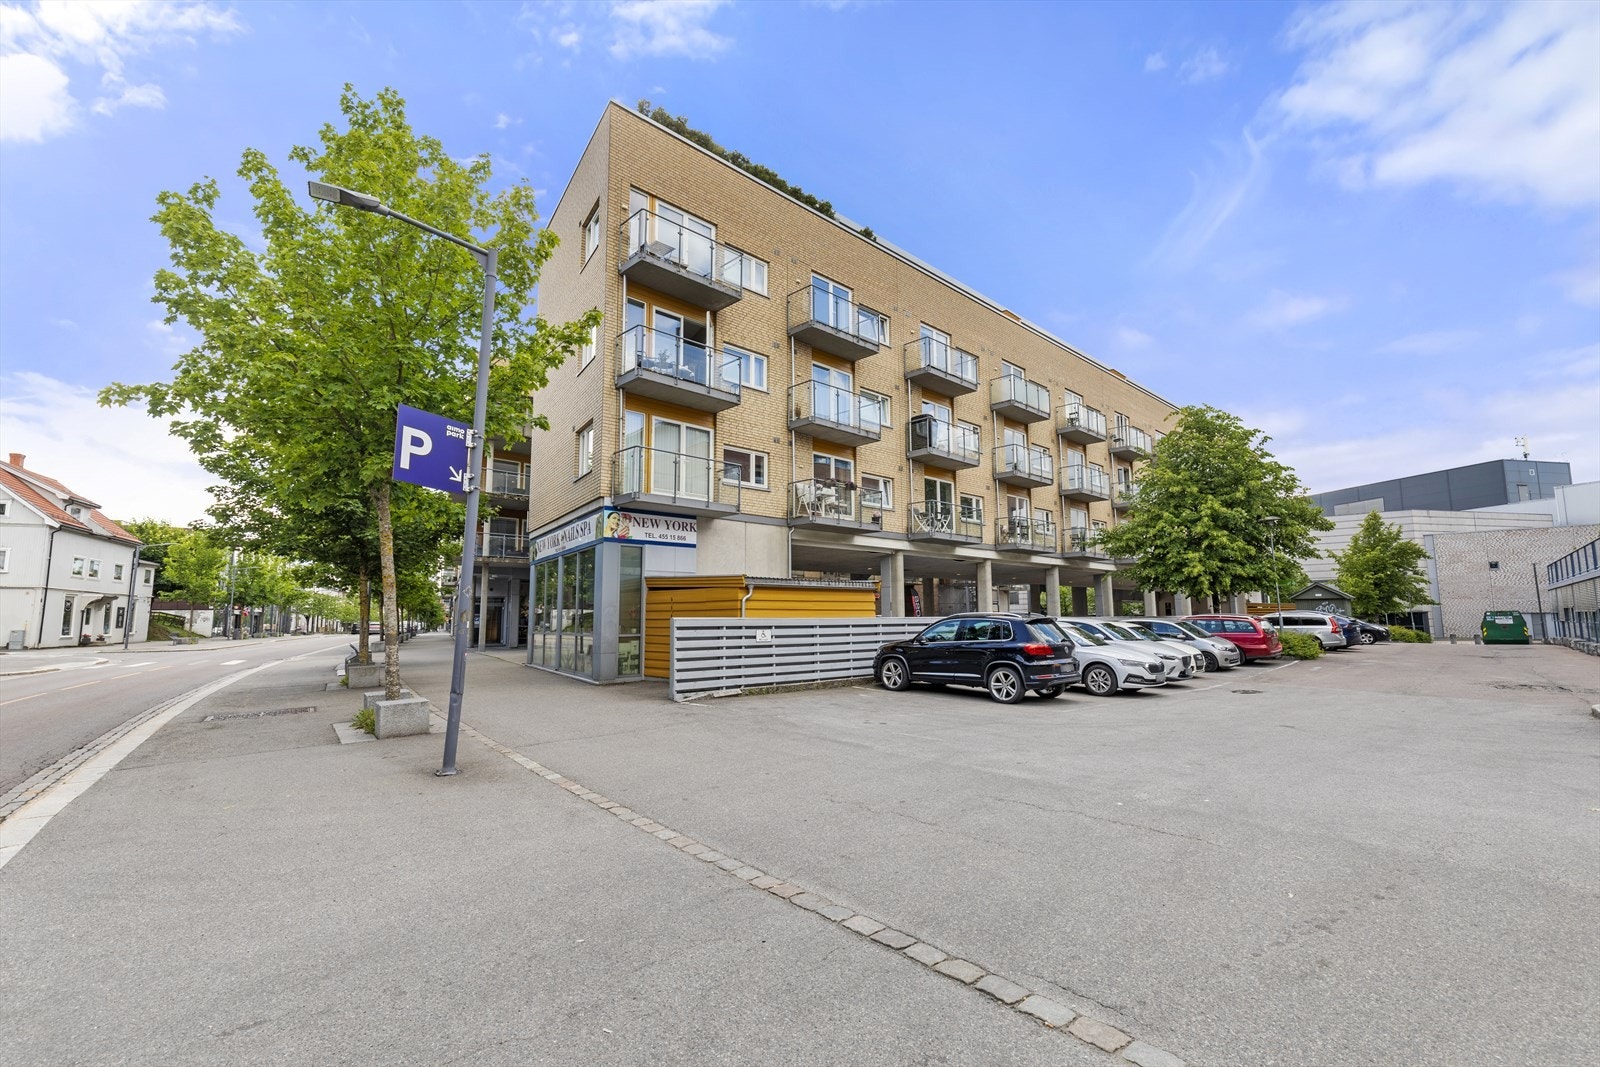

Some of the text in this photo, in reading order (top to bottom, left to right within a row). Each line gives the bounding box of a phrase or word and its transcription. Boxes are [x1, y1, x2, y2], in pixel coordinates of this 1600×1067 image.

[447, 425, 465, 434] aimo
[447, 430, 464, 439] park
[400, 426, 432, 470] P
[632, 516, 697, 532] NEW YORK
[547, 532, 561, 550] YORK
[563, 524, 580, 543] NAILS
[580, 520, 592, 538] SPA
